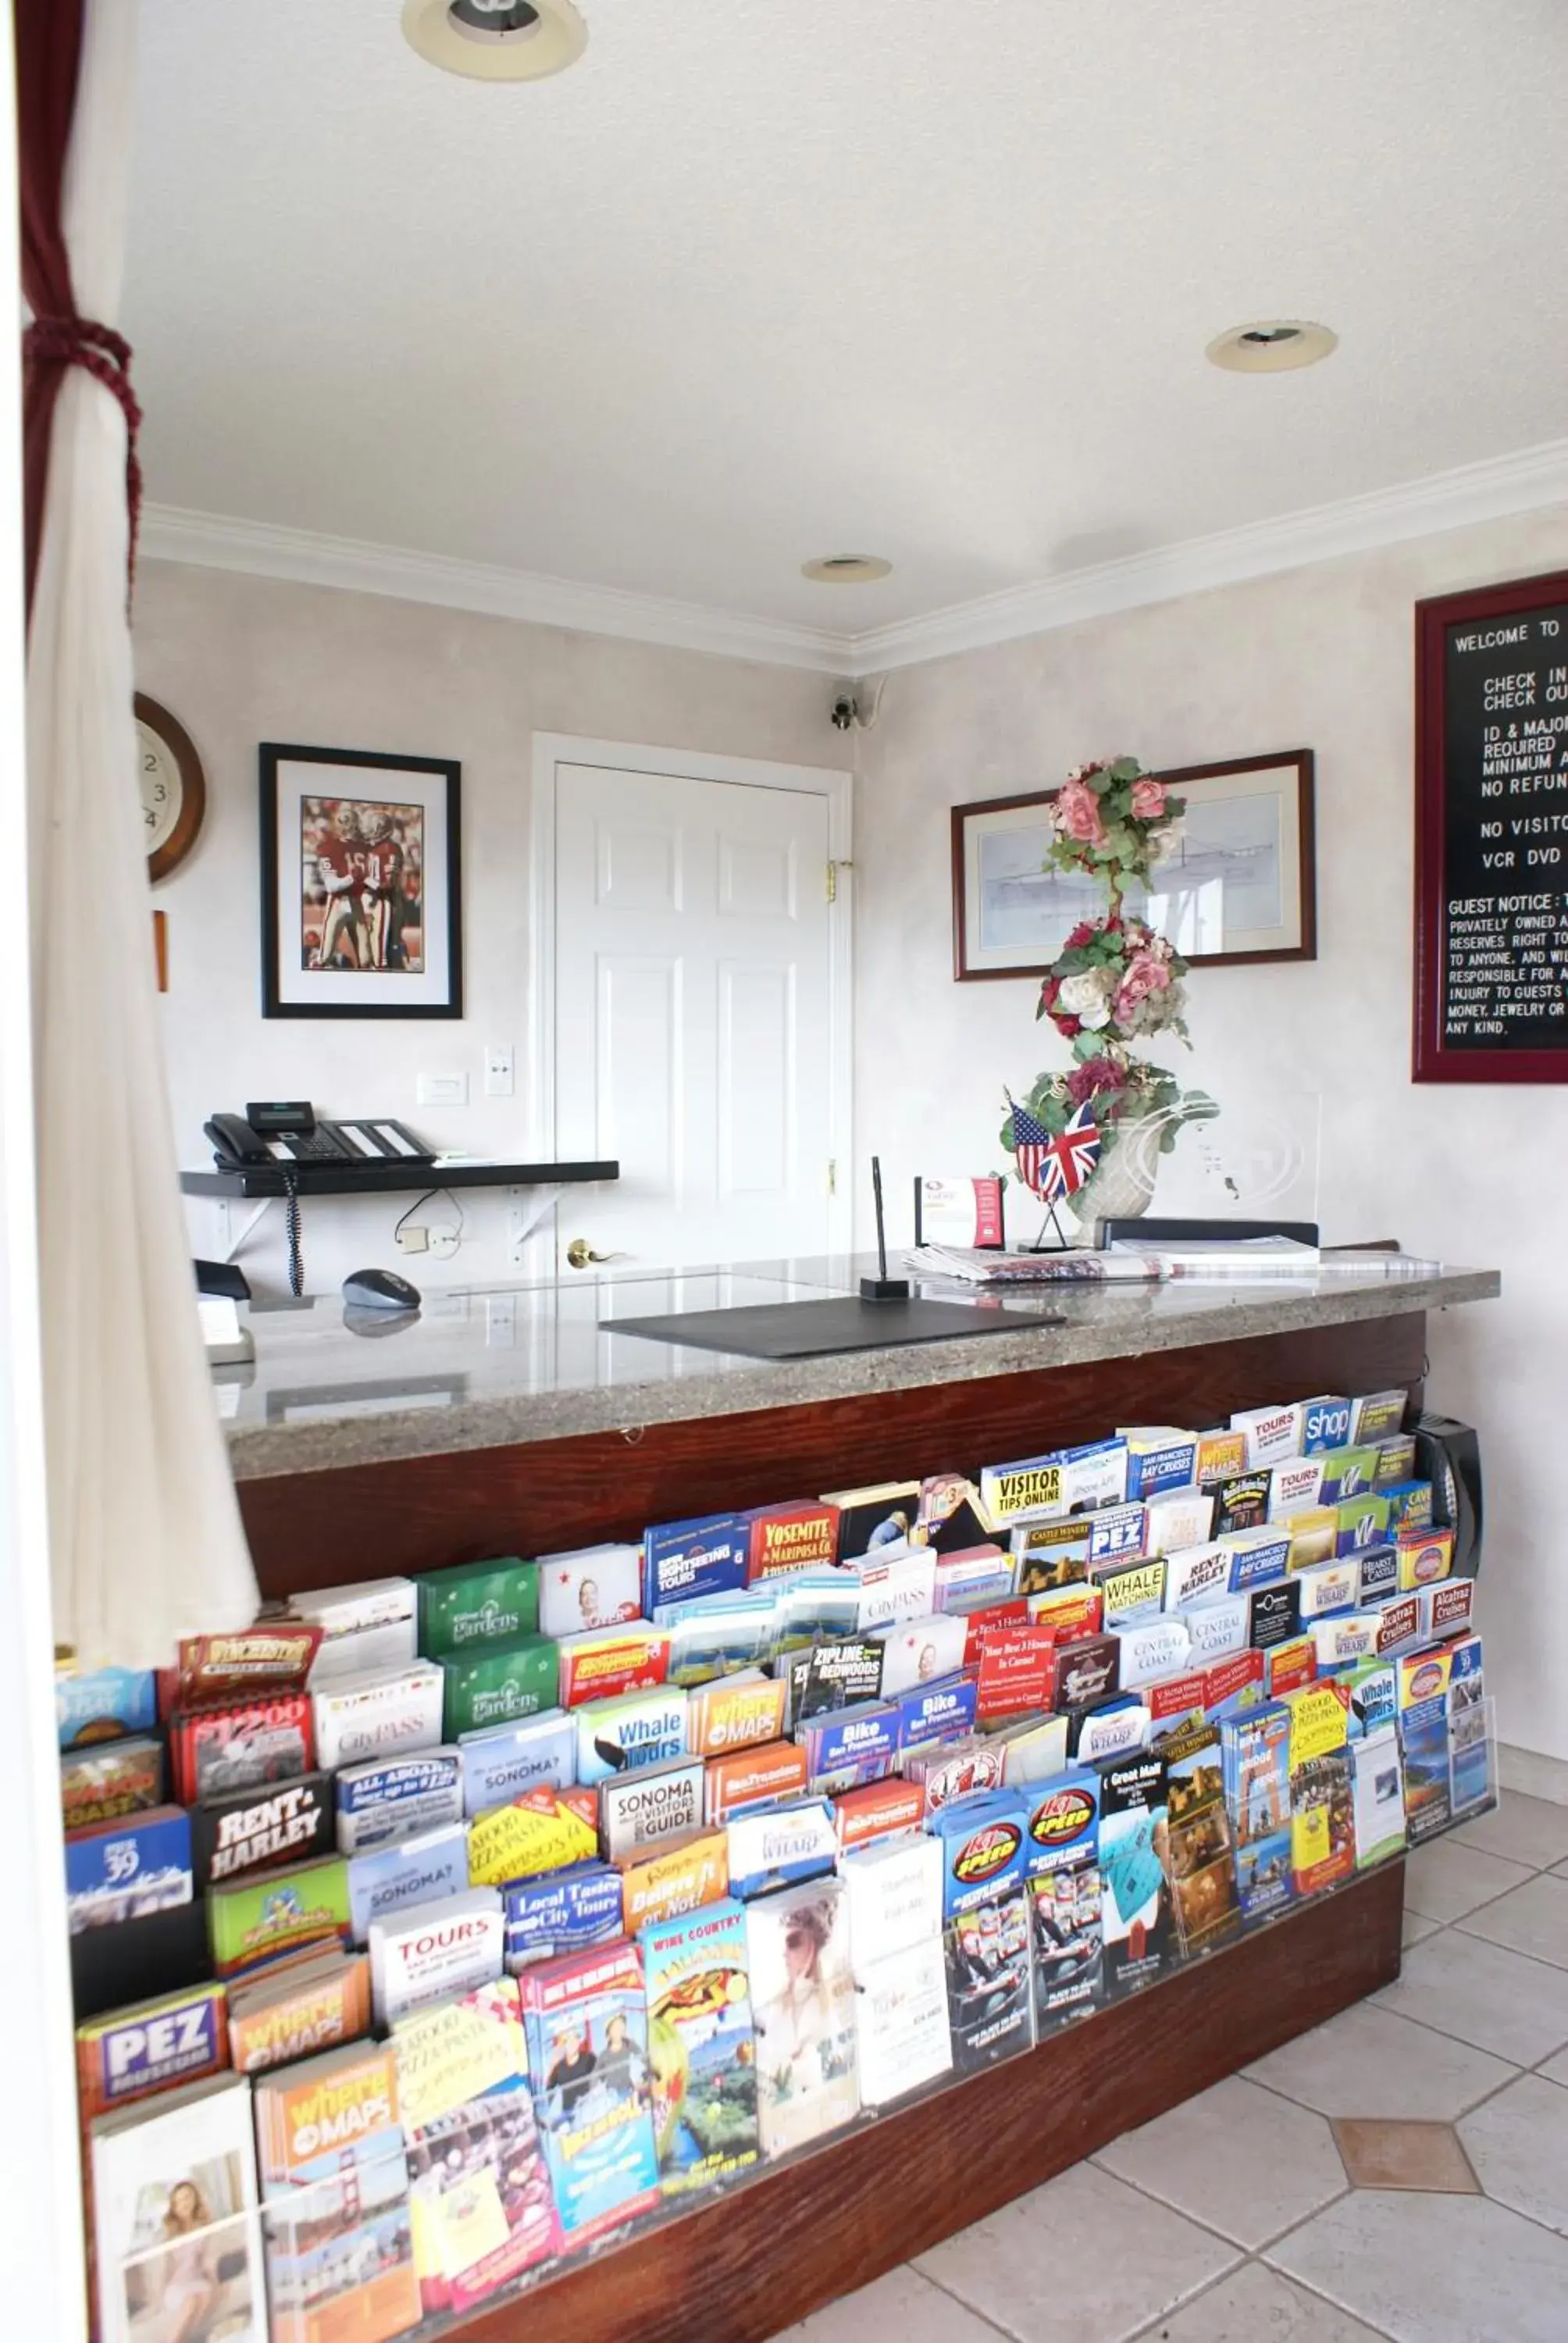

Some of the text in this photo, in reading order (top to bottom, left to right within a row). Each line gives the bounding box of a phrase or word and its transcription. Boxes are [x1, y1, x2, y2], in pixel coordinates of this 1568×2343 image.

[1455, 620, 1559, 653] WELCOME TO
[1483, 667, 1566, 695] CHECK IN
[1483, 690, 1535, 711] CHECK
[1484, 726, 1500, 744] ID
[1508, 722, 1517, 739] &
[144, 754, 156, 772] 2
[1482, 754, 1552, 777] MINIMUM
[155, 785, 165, 801] 3
[1481, 780, 1503, 798] NO
[144, 811, 155, 827] 4
[1480, 822, 1502, 839] NO
[1482, 847, 1561, 869] VCR DVD
[1449, 898, 1495, 915] GUEST
[1450, 918, 1508, 933] PRIVATELY
[1515, 915, 1556, 929] OWNED
[1449, 935, 1506, 950] RESERVES
[1512, 932, 1546, 947] RIGHT
[1449, 954, 1464, 966] TO
[1521, 950, 1545, 964] AND
[1449, 968, 1526, 983] RESPONSIBLE
[1531, 967, 1554, 981] FOR
[1449, 986, 1490, 1000] INJURY
[1495, 985, 1511, 998] TO
[1514, 985, 1563, 999] GUESTS
[1492, 1002, 1546, 1016] JEWELRY
[1548, 1002, 1566, 1015] OR
[1445, 1022, 1469, 1035] ANY
[1256, 1410, 1294, 1437] TOURS
[1307, 1408, 1349, 1441] shop
[1000, 1468, 1060, 1497] VISITOR
[1281, 1466, 1320, 1488] TOURS
[1000, 1487, 1060, 1512] TIPS ONLINE
[765, 1517, 831, 1548] YOSEMITE
[1093, 1522, 1142, 1555] PEZ
[772, 1542, 816, 1563] MARIPOSA
[1189, 1553, 1222, 1578] RENT
[1107, 1567, 1161, 1599] WHALE
[1179, 1562, 1227, 1596] HARLEY
[1109, 1588, 1160, 1613] WATCHING
[814, 1645, 864, 1666] ZIPLINE
[819, 1660, 880, 1680] REDWOODS
[1361, 1678, 1392, 1703] Whale
[922, 1693, 957, 1719] Bike
[618, 1711, 682, 1745] Whale
[842, 1721, 880, 1746] Bike
[1111, 1761, 1162, 1788] Great Mall
[617, 1780, 693, 1817] SONOMA
[646, 1797, 695, 1821] VISITORS
[218, 1786, 304, 1850] RENT
[647, 1811, 694, 1838] GUIDE
[211, 1807, 323, 1881] HARLEY
[106, 1848, 139, 1884] 39
[519, 1888, 565, 1913] Local
[574, 1896, 618, 1919] Tours
[398, 1919, 489, 1962] TOURS
[654, 1913, 742, 1952] WINE COUNTRY
[108, 2003, 208, 2084] PEZ
[290, 2071, 387, 2131] where
[315, 2096, 392, 2145] MAPS
